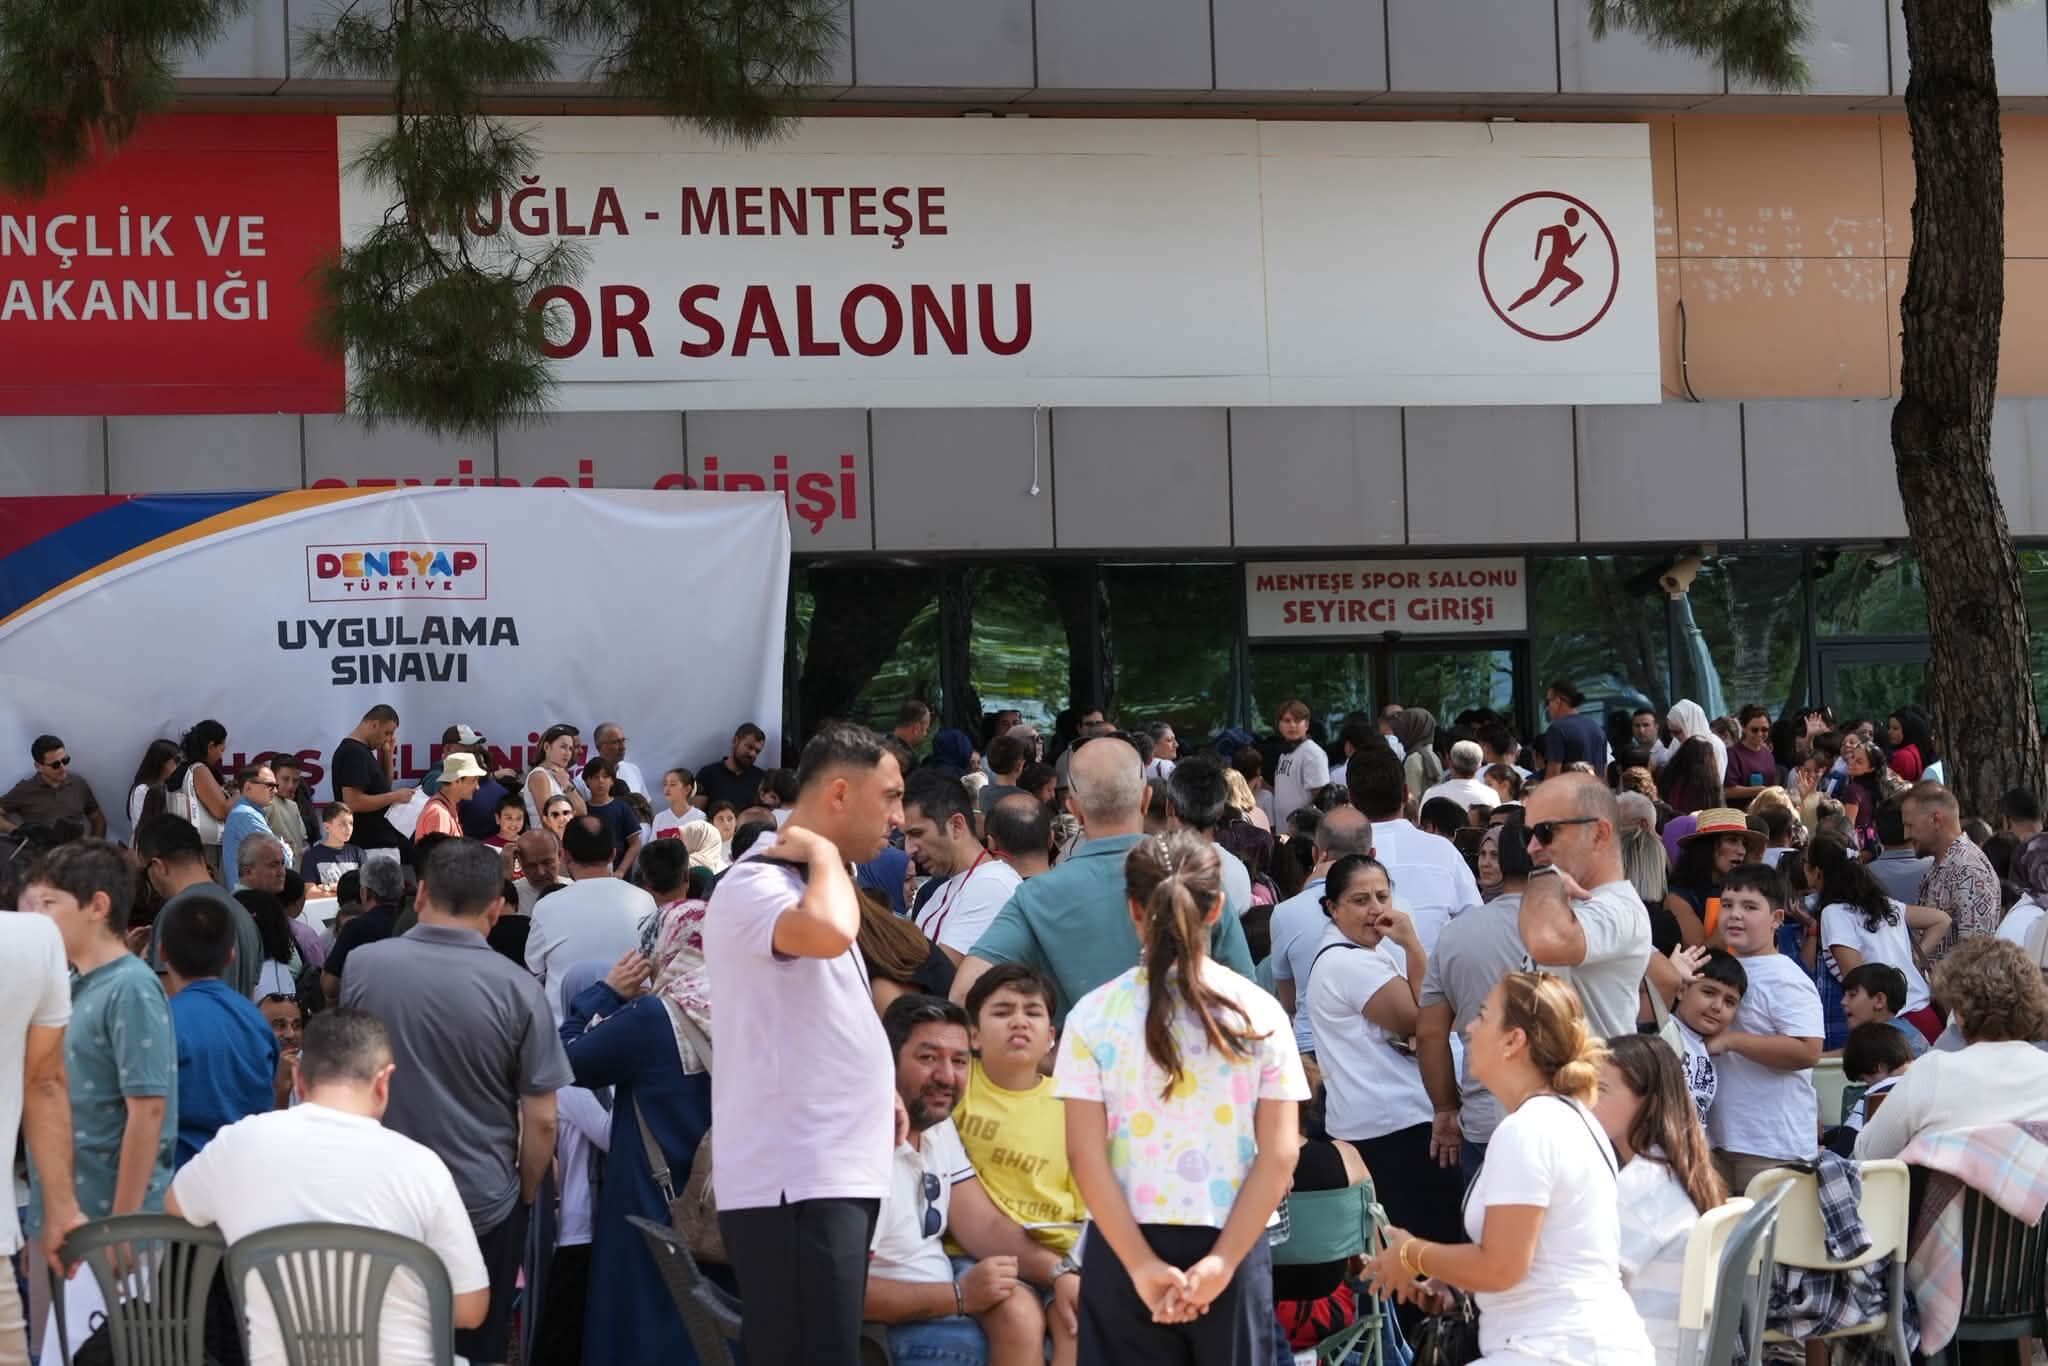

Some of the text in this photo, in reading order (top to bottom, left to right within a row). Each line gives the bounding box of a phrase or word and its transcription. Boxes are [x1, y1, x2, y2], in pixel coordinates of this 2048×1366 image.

[645, 212, 660, 220] -
[681, 186, 948, 250] MENTEŞE
[194, 215, 266, 257] VE
[0, 270, 268, 321] AKANLIĞI
[678, 283, 1033, 358] SALONU
[316, 550, 478, 579] DENEYAP
[1255, 569, 1518, 595] MENTEŞE SPOR SALONU
[343, 577, 453, 592] TÜRKİYE
[277, 615, 520, 650] UYGULAMA
[331, 652, 468, 686] SINAVI
